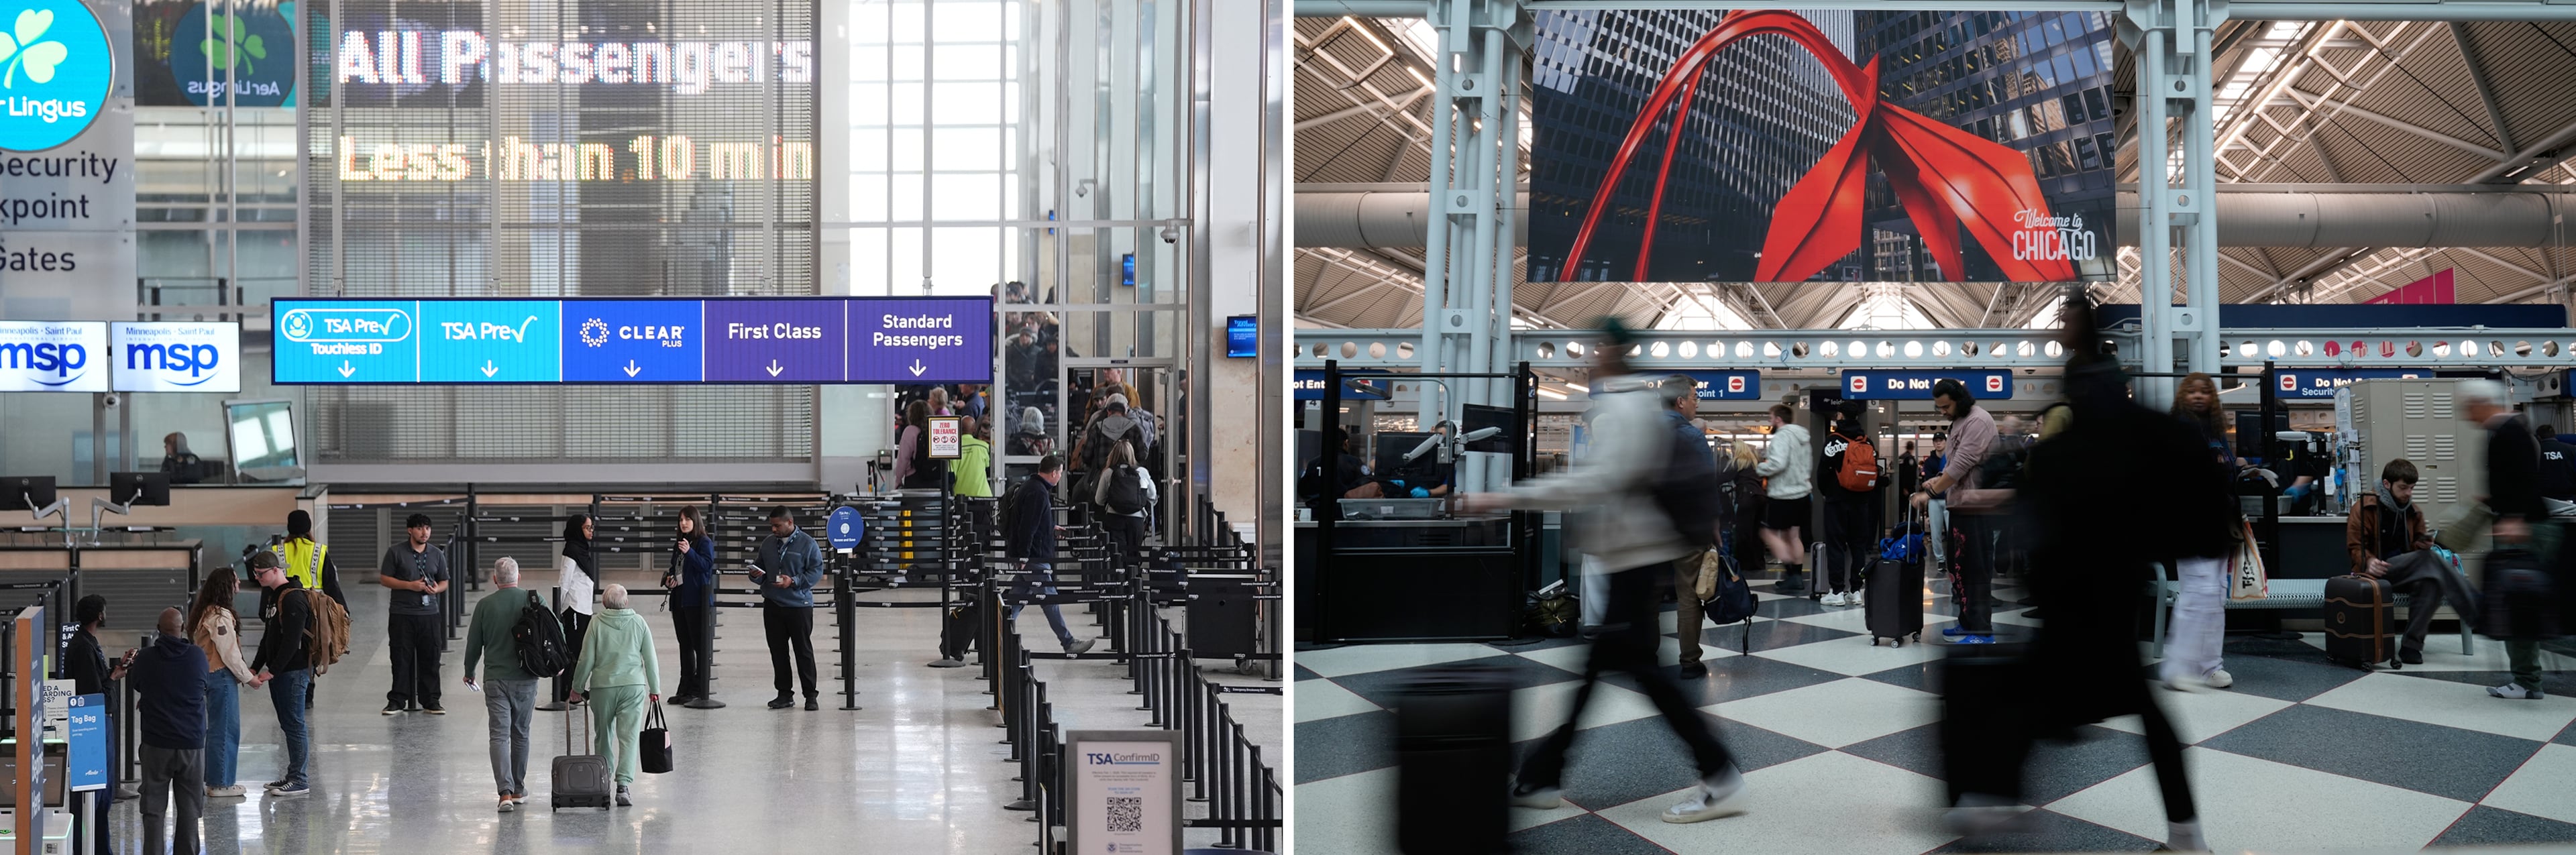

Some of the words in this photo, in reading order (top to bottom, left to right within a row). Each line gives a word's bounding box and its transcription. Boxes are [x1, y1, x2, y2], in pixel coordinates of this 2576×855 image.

[338, 31, 425, 84] All
[9, 95, 87, 123] Lingus
[339, 135, 470, 182] Less
[630, 135, 696, 181] 10
[2014, 209, 2070, 229] Welcome
[2013, 230, 2096, 261] CHICAGO
[325, 319, 352, 333] TSA
[882, 314, 953, 329] Standard
[45, 327, 64, 335] Saint
[126, 327, 172, 337] Minneapolis
[441, 322, 476, 340] TSA
[619, 326, 682, 340] CLEAR
[729, 323, 769, 340] First
[773, 323, 822, 340] Class
[873, 332, 963, 349] Passengers
[311, 343, 367, 355] Touchless
[369, 343, 382, 354] ID
[127, 343, 219, 378] msp
[1888, 379, 1904, 390] Do
[1909, 379, 1930, 390] Not
[2316, 378, 2330, 388] Do
[2544, 451, 2563, 460] TSA
[71, 716, 83, 724] Tag
[84, 714, 96, 723] Bag
[1087, 753, 1114, 765] TSA
[1114, 753, 1160, 762] ConfirmID
